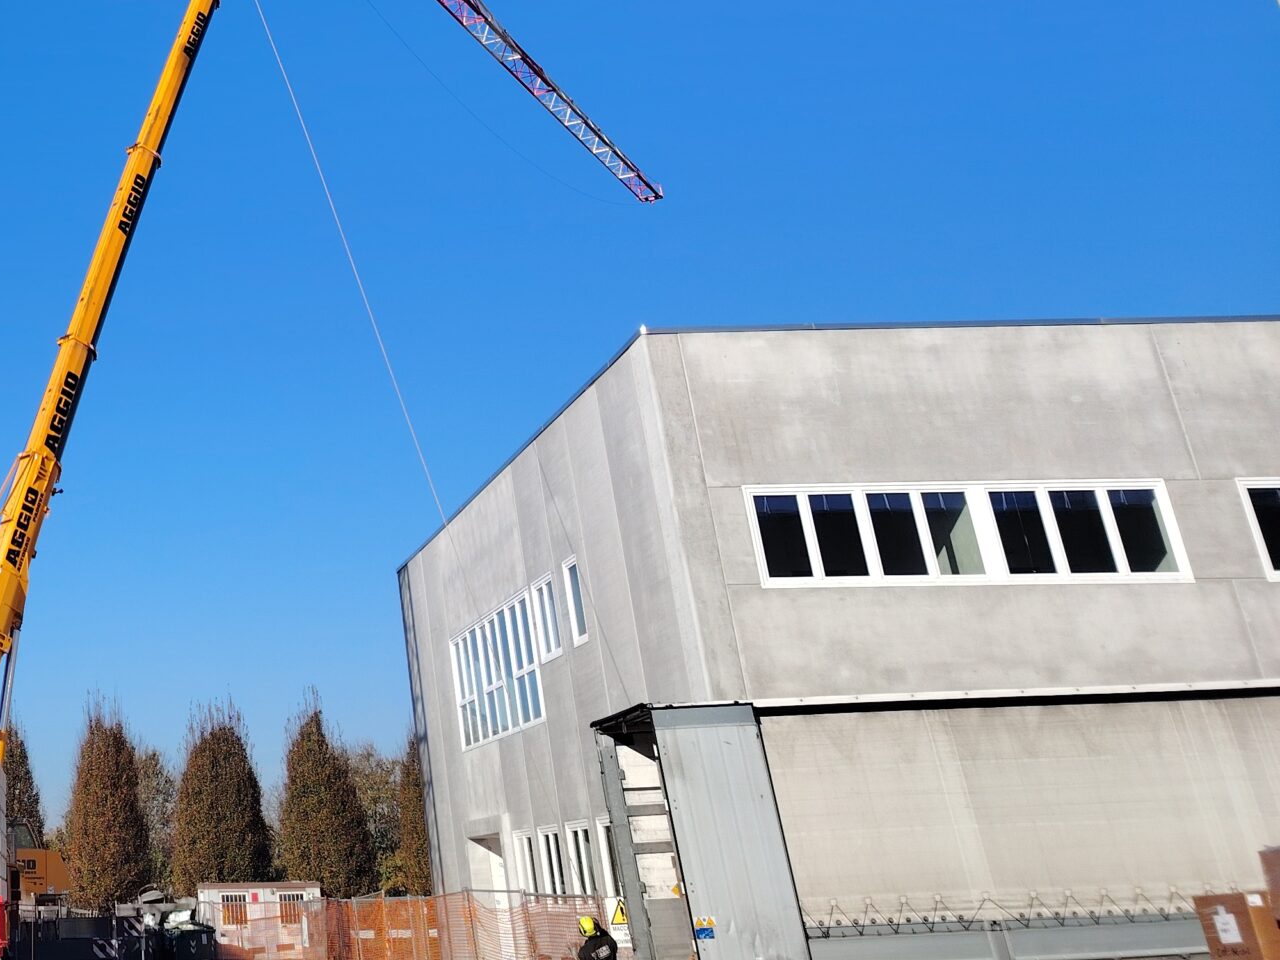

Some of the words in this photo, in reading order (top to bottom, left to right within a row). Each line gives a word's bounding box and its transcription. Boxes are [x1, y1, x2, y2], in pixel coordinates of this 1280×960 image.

[183, 11, 208, 61] AGGIO
[117, 173, 146, 237] AGGIO
[44, 370, 80, 457] AGGIO
[5, 486, 40, 569] AGGIO
